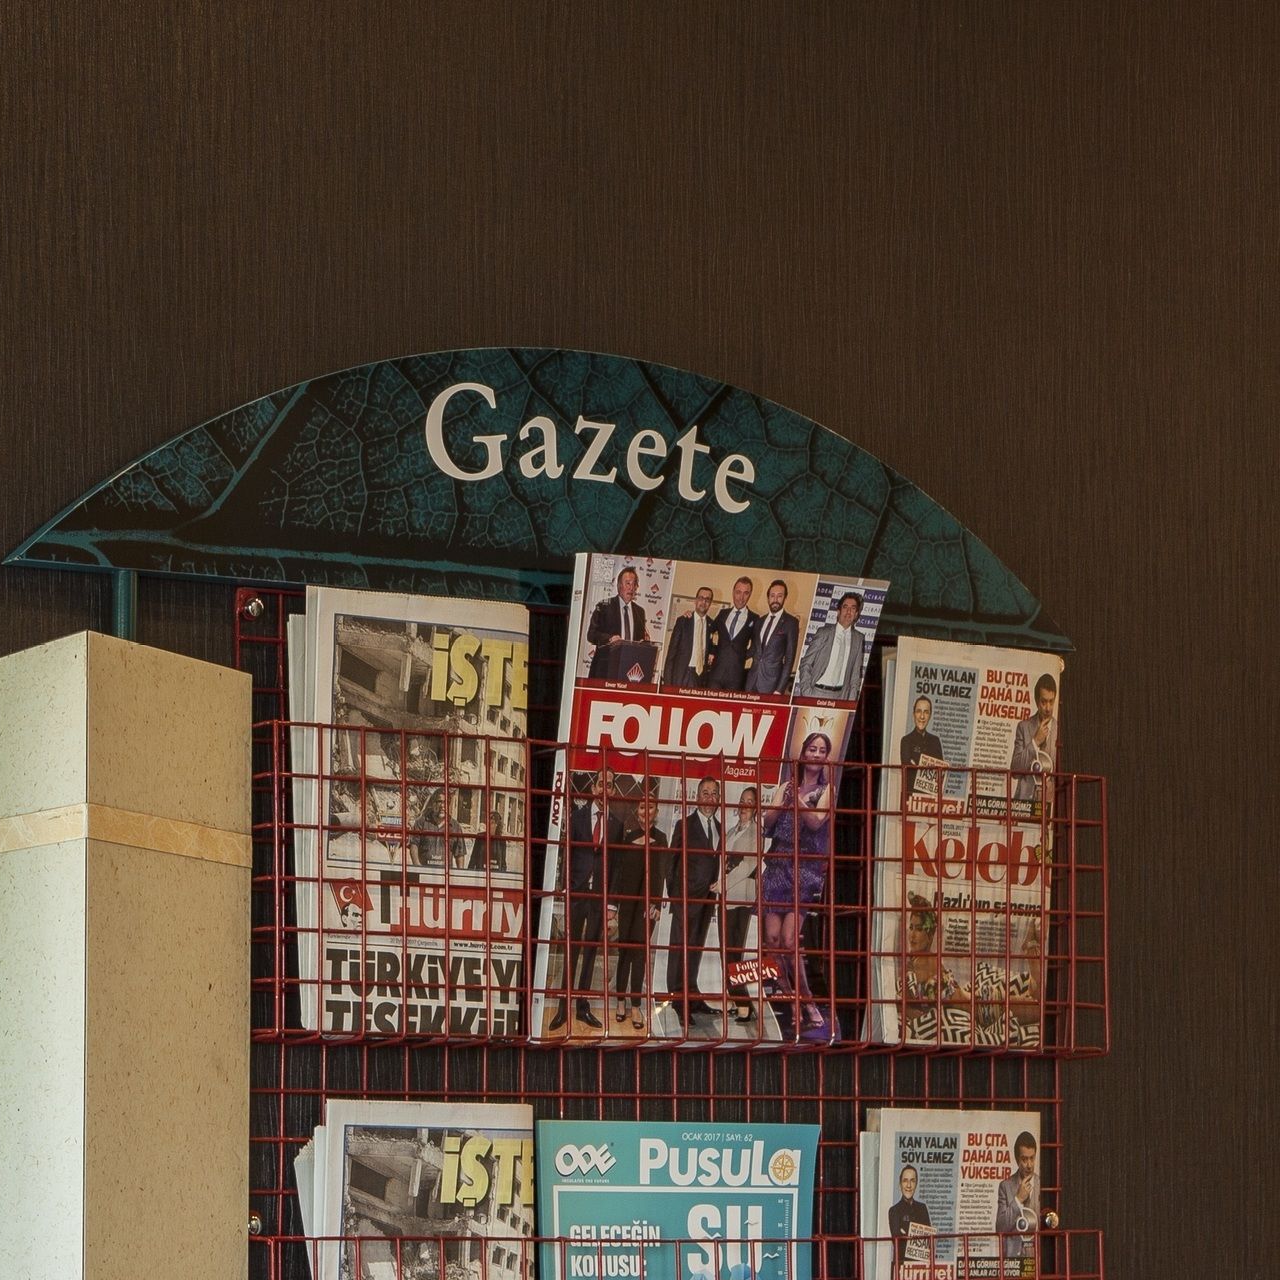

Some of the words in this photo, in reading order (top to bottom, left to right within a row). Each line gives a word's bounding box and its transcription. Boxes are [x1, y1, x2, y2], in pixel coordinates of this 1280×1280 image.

[425, 382, 757, 513] Gazete
[915, 665, 937, 681] KAN
[941, 668, 976, 684] YALAN
[986, 669, 1000, 684] BU
[916, 680, 972, 699] SÖYLEMEZ
[981, 686, 1012, 702] DAHA
[1016, 690, 1031, 704] DA
[586, 700, 775, 765] FOLLOW
[735, 961, 764, 972] Follo
[682, 1132, 703, 1141] OCAK
[704, 1133, 721, 1141] 2017
[744, 1134, 753, 1142] 62
[899, 1136, 921, 1148] KAN
[924, 1136, 957, 1149] YALAN
[967, 1133, 982, 1147] BU
[555, 1143, 617, 1177] ODE
[901, 1148, 954, 1164] SÖYLEMEZ
[962, 1149, 993, 1163] DAHA
[996, 1150, 1011, 1164] DA
[687, 1204, 763, 1276] SU
